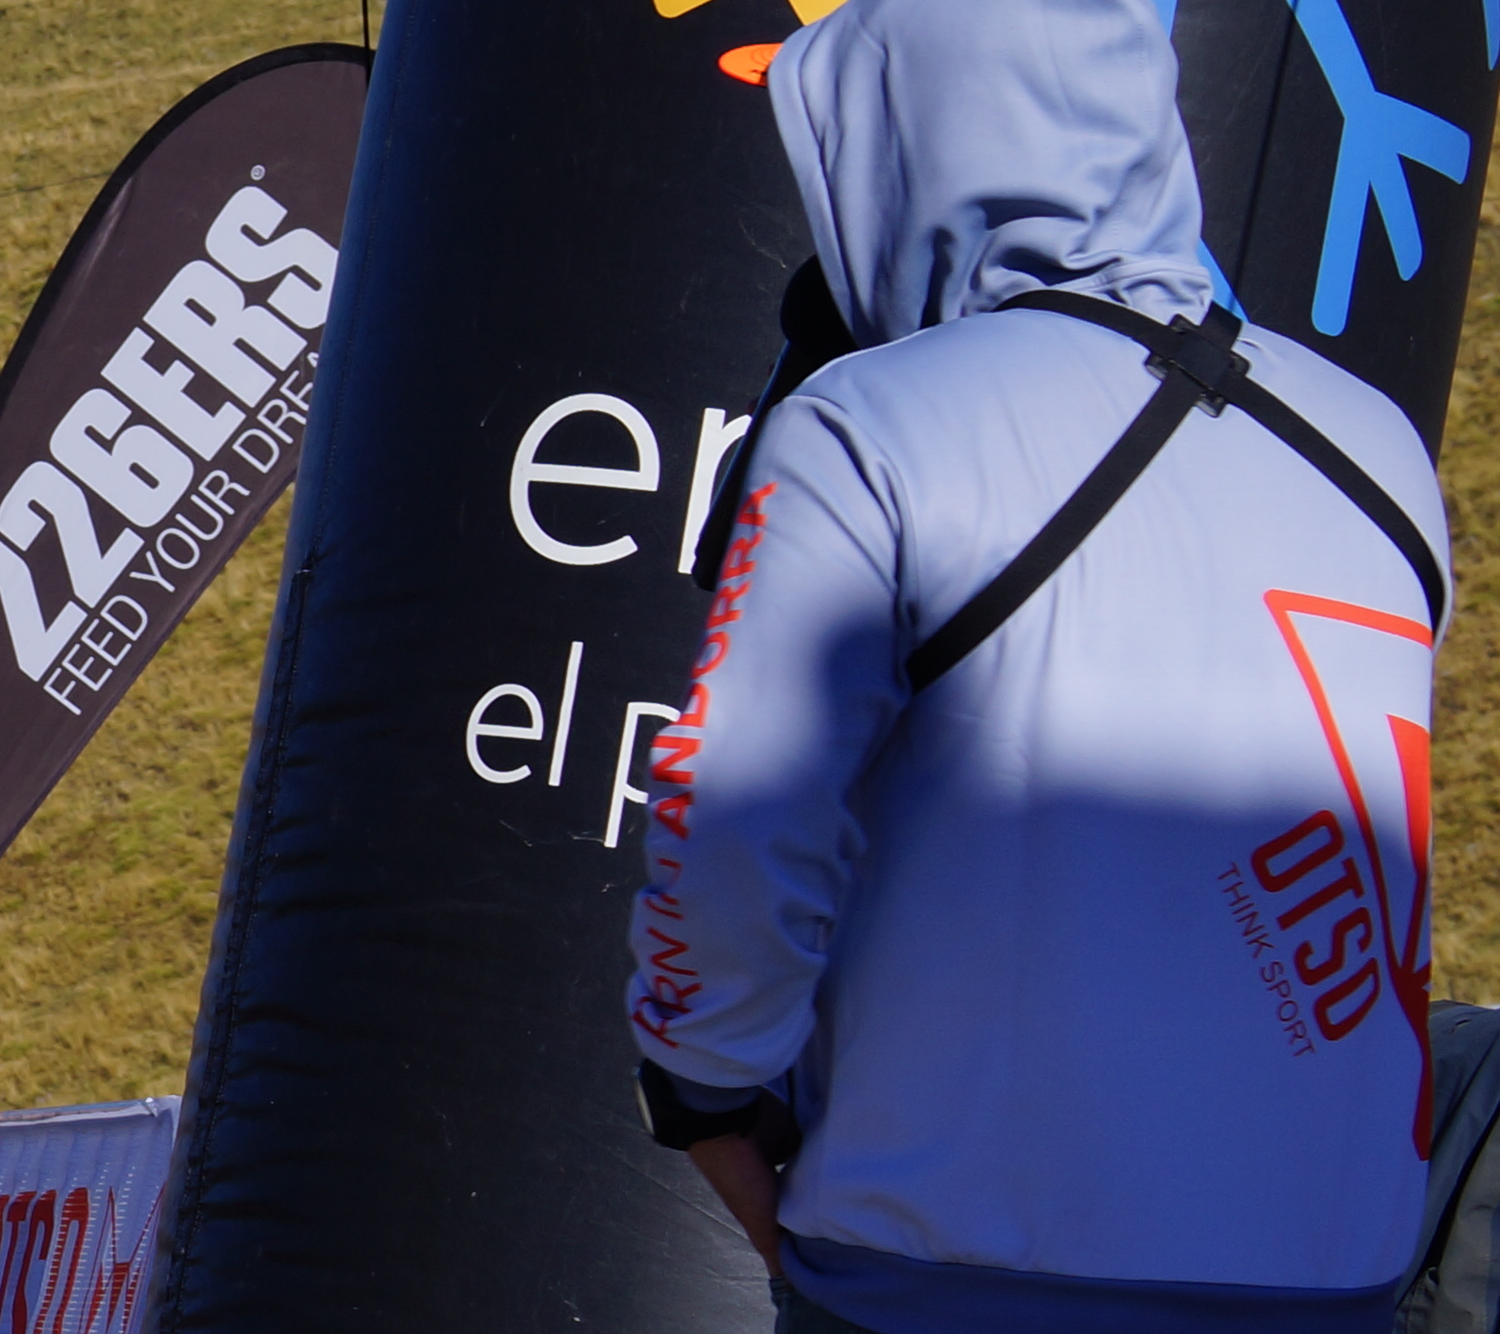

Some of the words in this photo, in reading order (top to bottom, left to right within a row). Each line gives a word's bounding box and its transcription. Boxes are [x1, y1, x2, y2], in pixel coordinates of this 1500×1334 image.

[42, 592, 149, 716] FEED
[130, 467, 251, 595] YOUR
[465, 641, 583, 787] el
[1217, 861, 1275, 960] THINK
[1260, 960, 1317, 1058] SPORT
